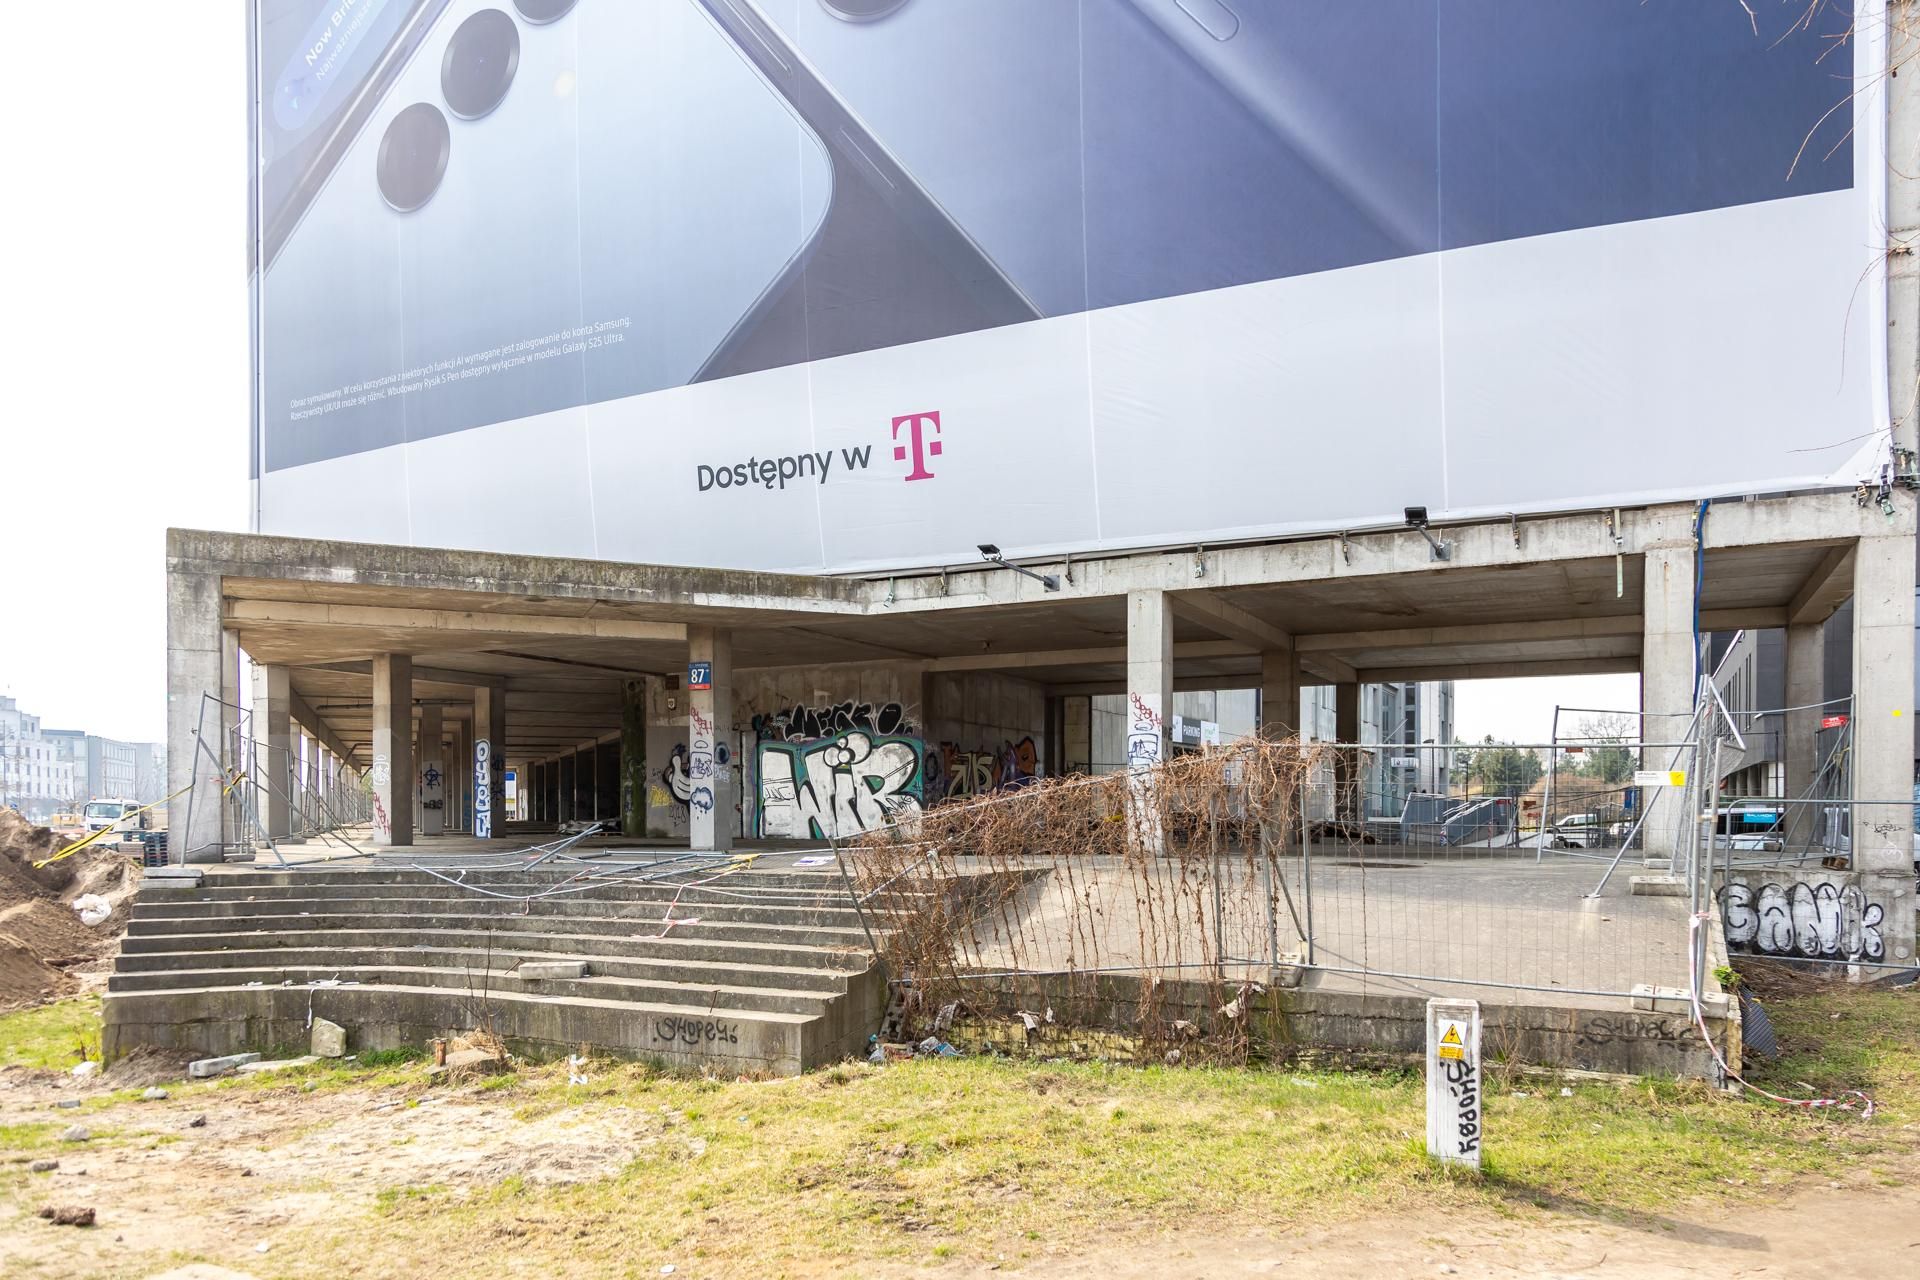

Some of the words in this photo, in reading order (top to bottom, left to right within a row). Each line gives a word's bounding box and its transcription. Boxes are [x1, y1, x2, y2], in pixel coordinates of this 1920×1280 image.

[305, 26, 332, 67] Now
[363, 374, 397, 390] korzystania
[434, 359, 456, 372] funkcji
[456, 355, 464, 367] AI
[464, 347, 501, 366] wymagane
[501, 342, 515, 357] jest
[515, 331, 561, 351] zalogowanie
[561, 328, 571, 340] do
[572, 324, 593, 338] konta
[594, 316, 632, 334] Samsung.
[424, 374, 441, 389] Rysik
[441, 373, 447, 384] S
[447, 371, 460, 382] Pen
[460, 362, 491, 379] dostępny
[491, 355, 526, 372] wyłącznie
[526, 353, 533, 363] w
[534, 346, 561, 360] modelu
[562, 340, 587, 354] Galaxy
[588, 336, 603, 349] S25
[697, 451, 833, 491] Dostępny
[841, 444, 872, 471] w
[691, 668, 705, 684] 87
[1183, 724, 1201, 738] PARKING
